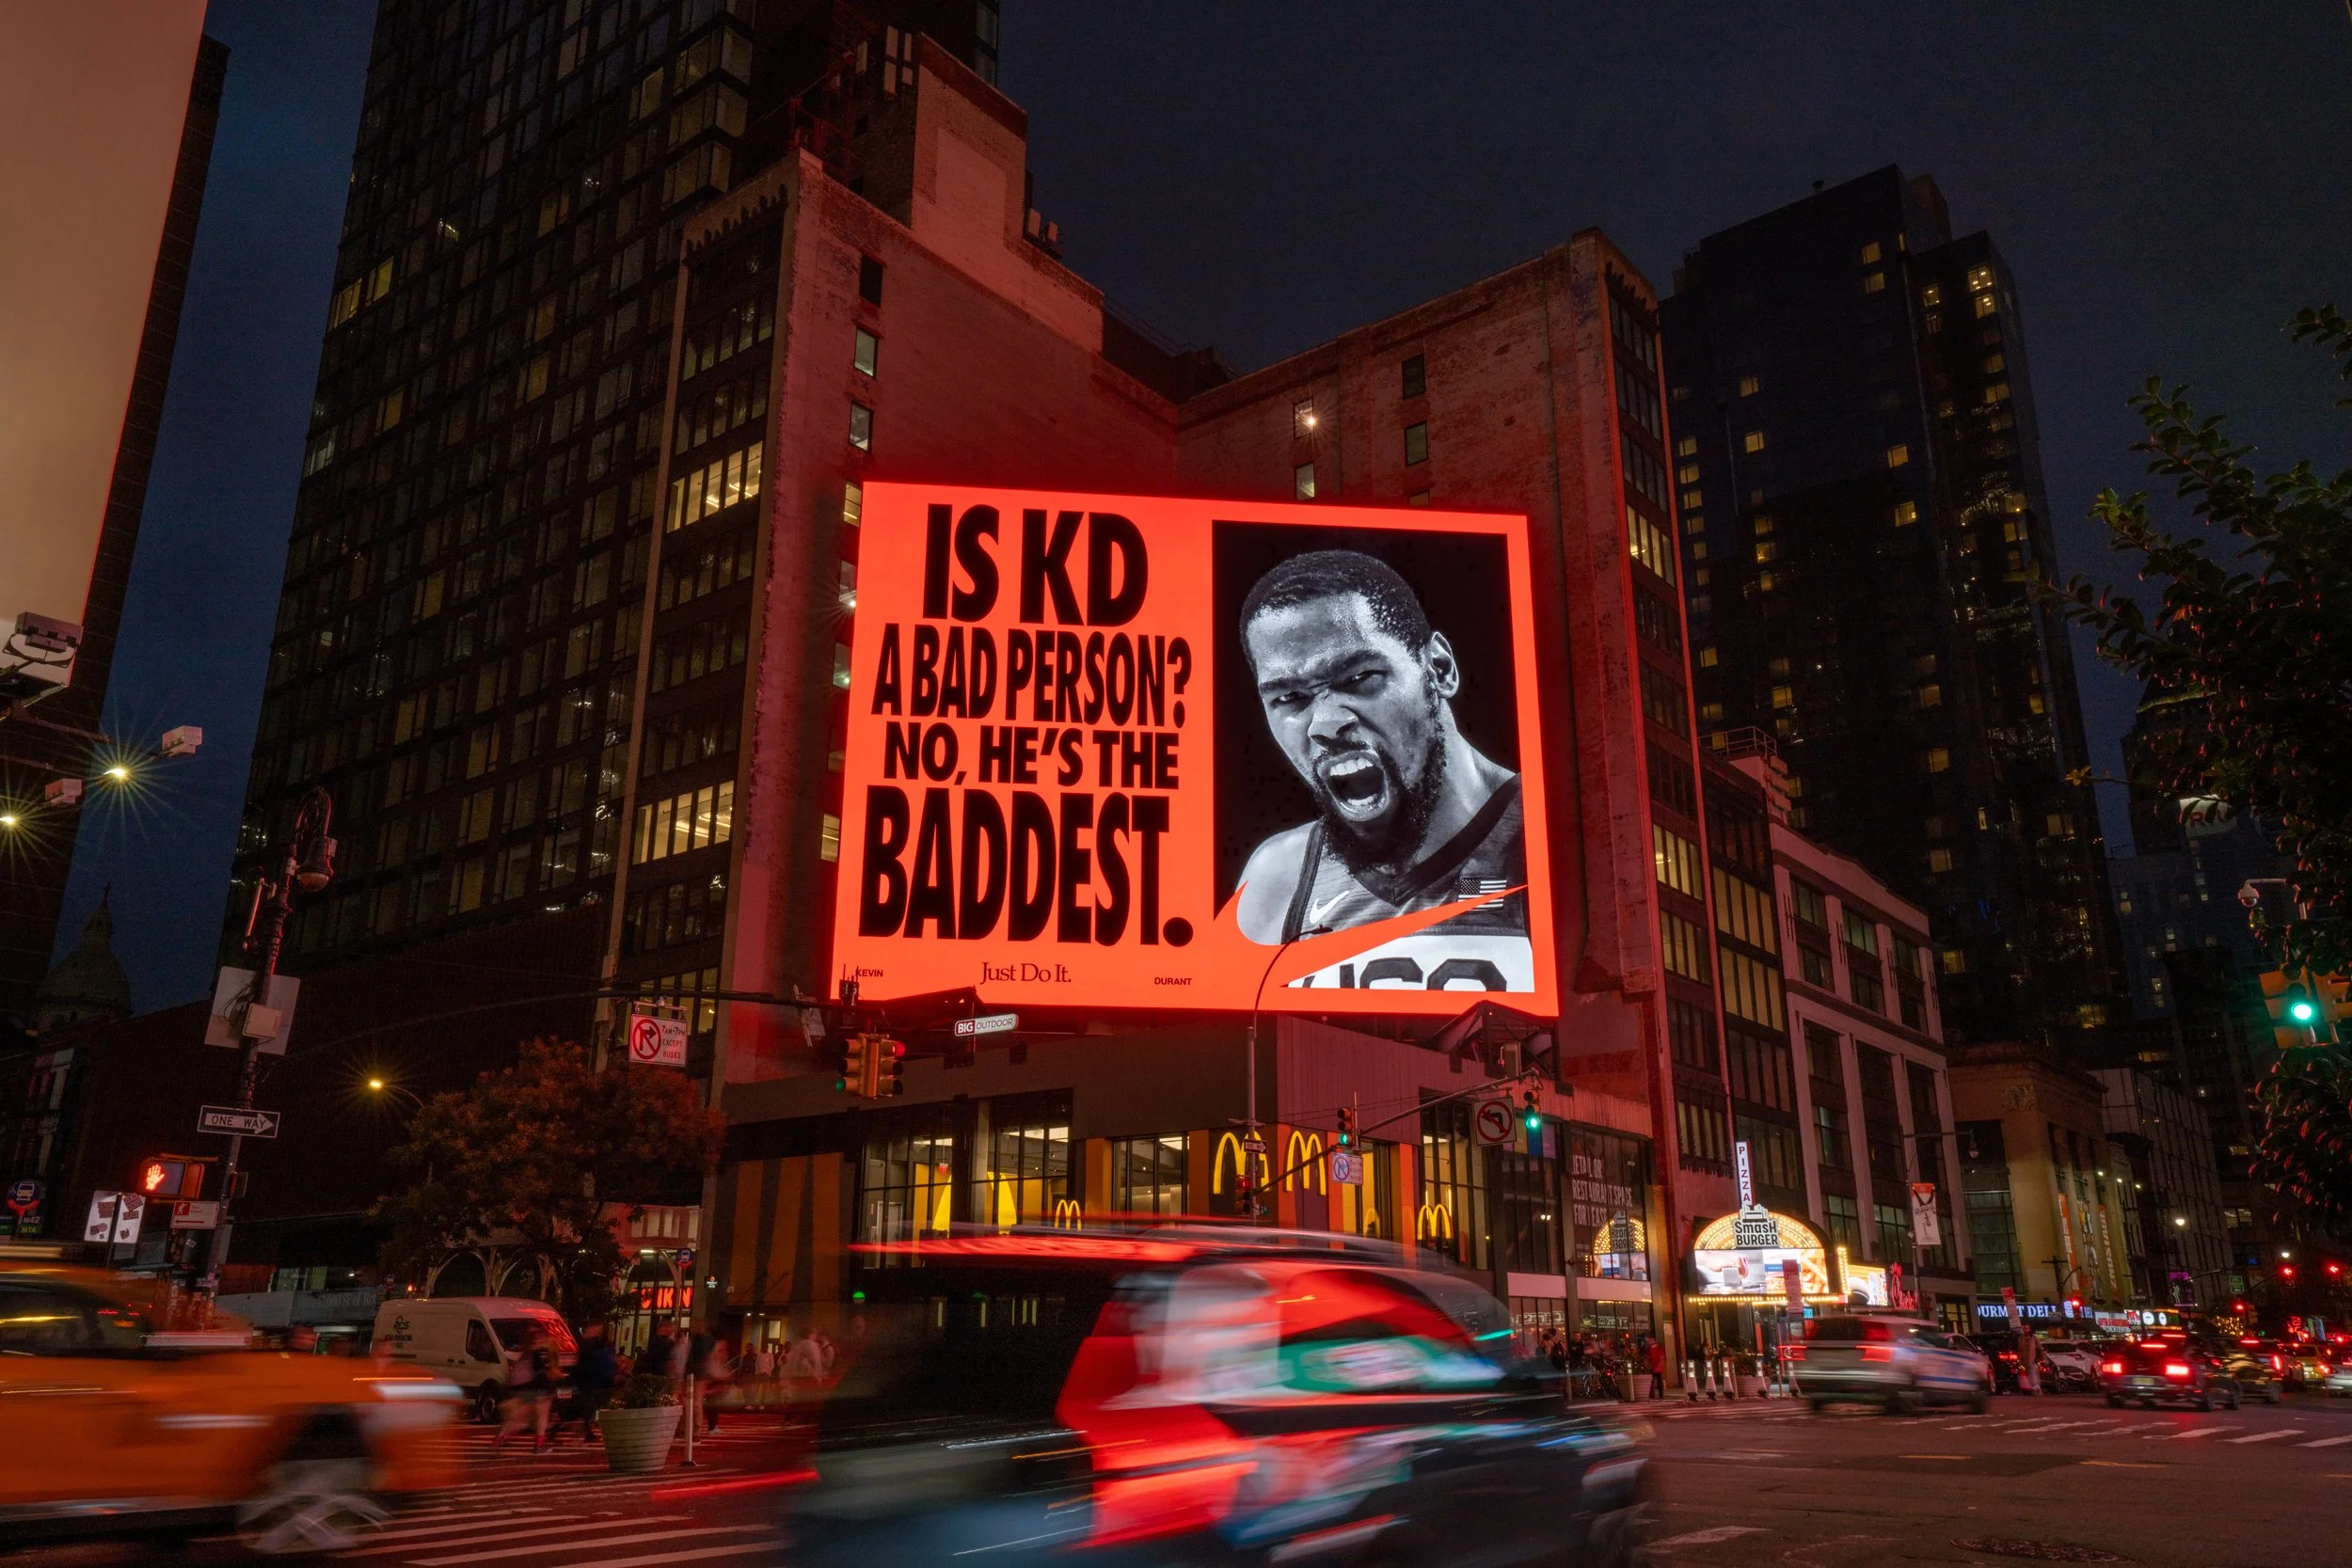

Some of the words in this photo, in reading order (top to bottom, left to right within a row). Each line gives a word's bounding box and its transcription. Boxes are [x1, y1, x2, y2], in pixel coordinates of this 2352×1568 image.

[922, 502, 1000, 623] IS
[1019, 508, 1149, 627] KD
[871, 623, 902, 716] A
[910, 624, 997, 719] BAD
[1005, 628, 1192, 729] PERSON?
[882, 721, 967, 786] NO,
[977, 725, 1083, 786] HE'S
[1092, 730, 1180, 790] THE
[858, 784, 1194, 947] BADDEST.
[856, 969, 883, 977] KEVIN
[979, 961, 1017, 985] Just
[1020, 962, 1052, 983] Do
[1055, 963, 1073, 983] It.
[1153, 976, 1192, 986] DURANT
[957, 1022, 974, 1034] BIG
[976, 1018, 1013, 1030] OUTDOOR
[211, 1115, 233, 1126] ONE
[244, 1119, 266, 1129] WAY
[1739, 1146, 1751, 1202] PIZZA
[1574, 1204, 1587, 1226] FOR
[1737, 1233, 1778, 1245] BURGER
